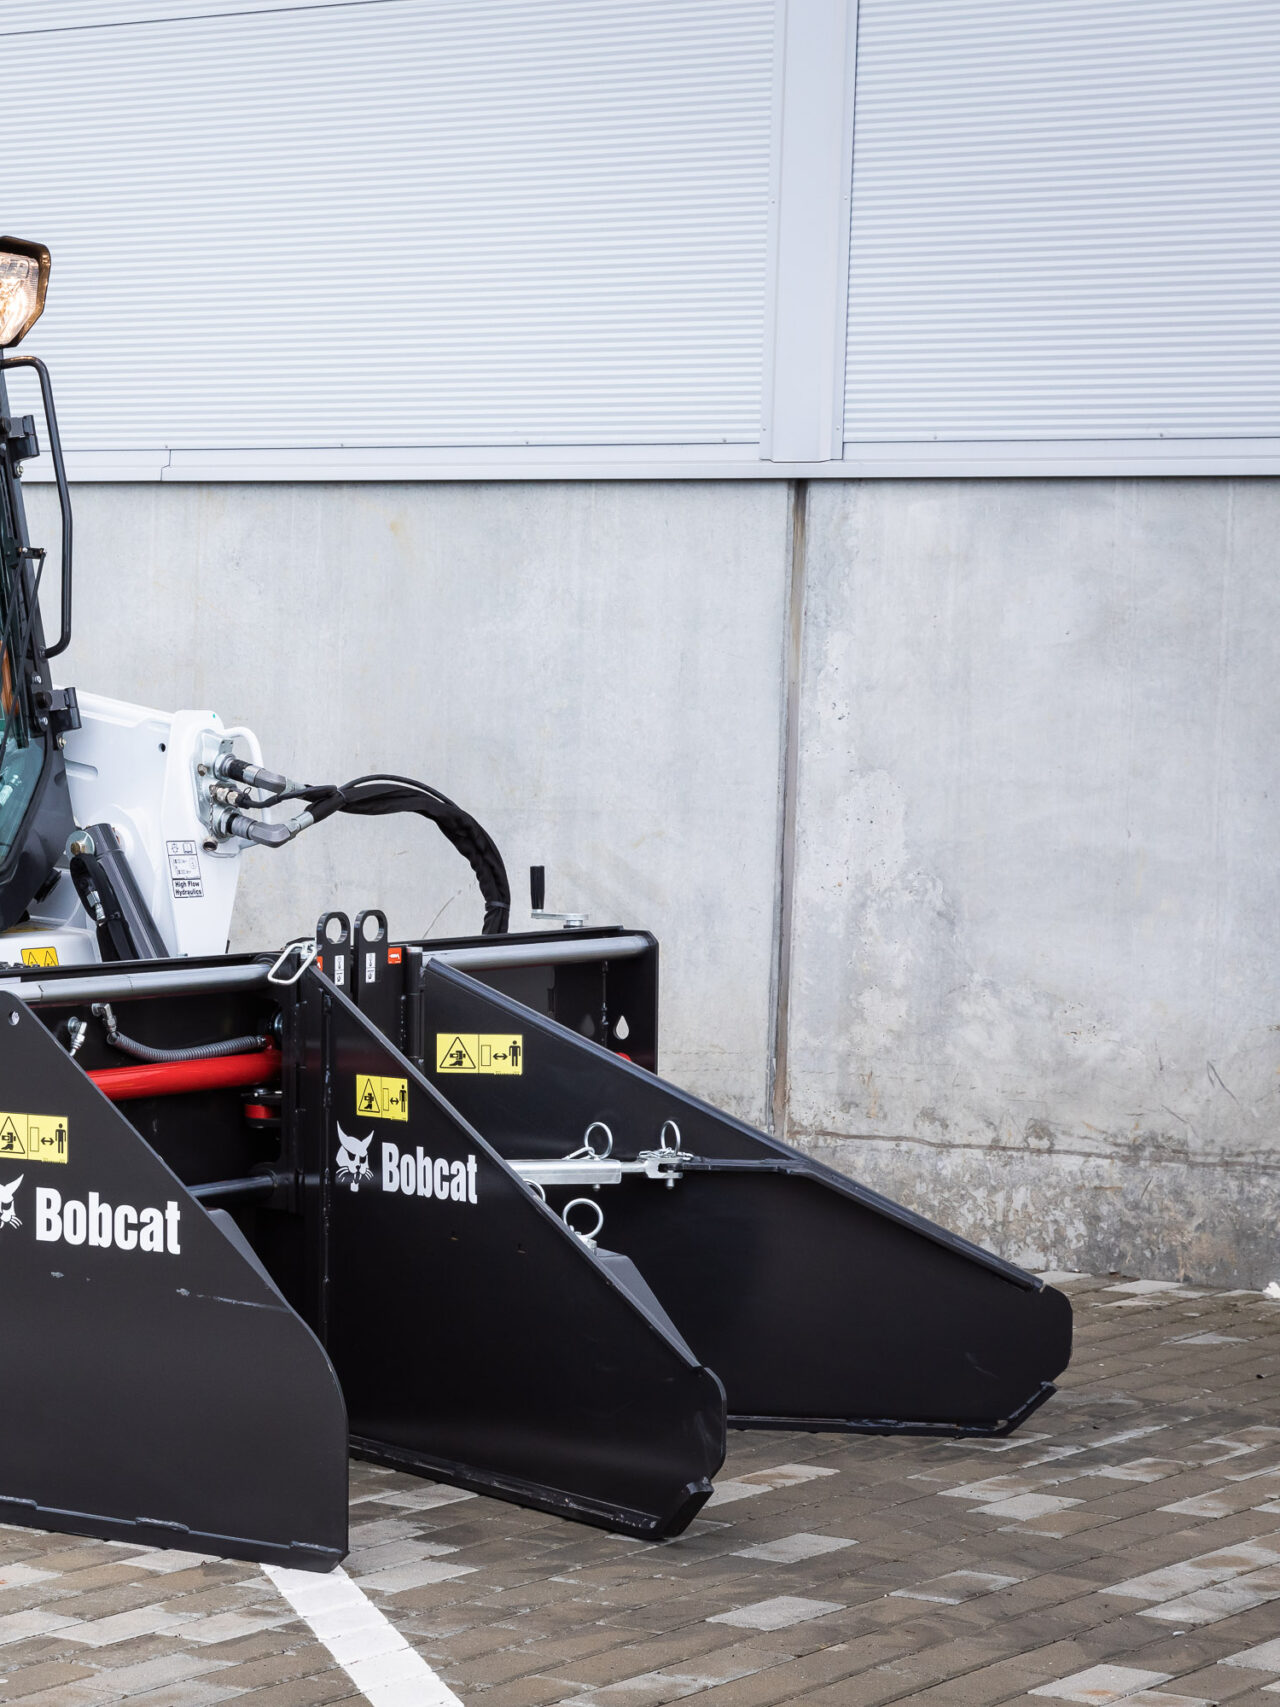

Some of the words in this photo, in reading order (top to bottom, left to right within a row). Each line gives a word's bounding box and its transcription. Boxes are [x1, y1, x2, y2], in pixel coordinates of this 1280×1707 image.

[174, 881, 187, 889] High
[187, 880, 200, 888] Flow
[175, 888, 202, 896] Hydraulics
[382, 1142, 478, 1204] Bobcat
[35, 1187, 181, 1255] Bobcat
